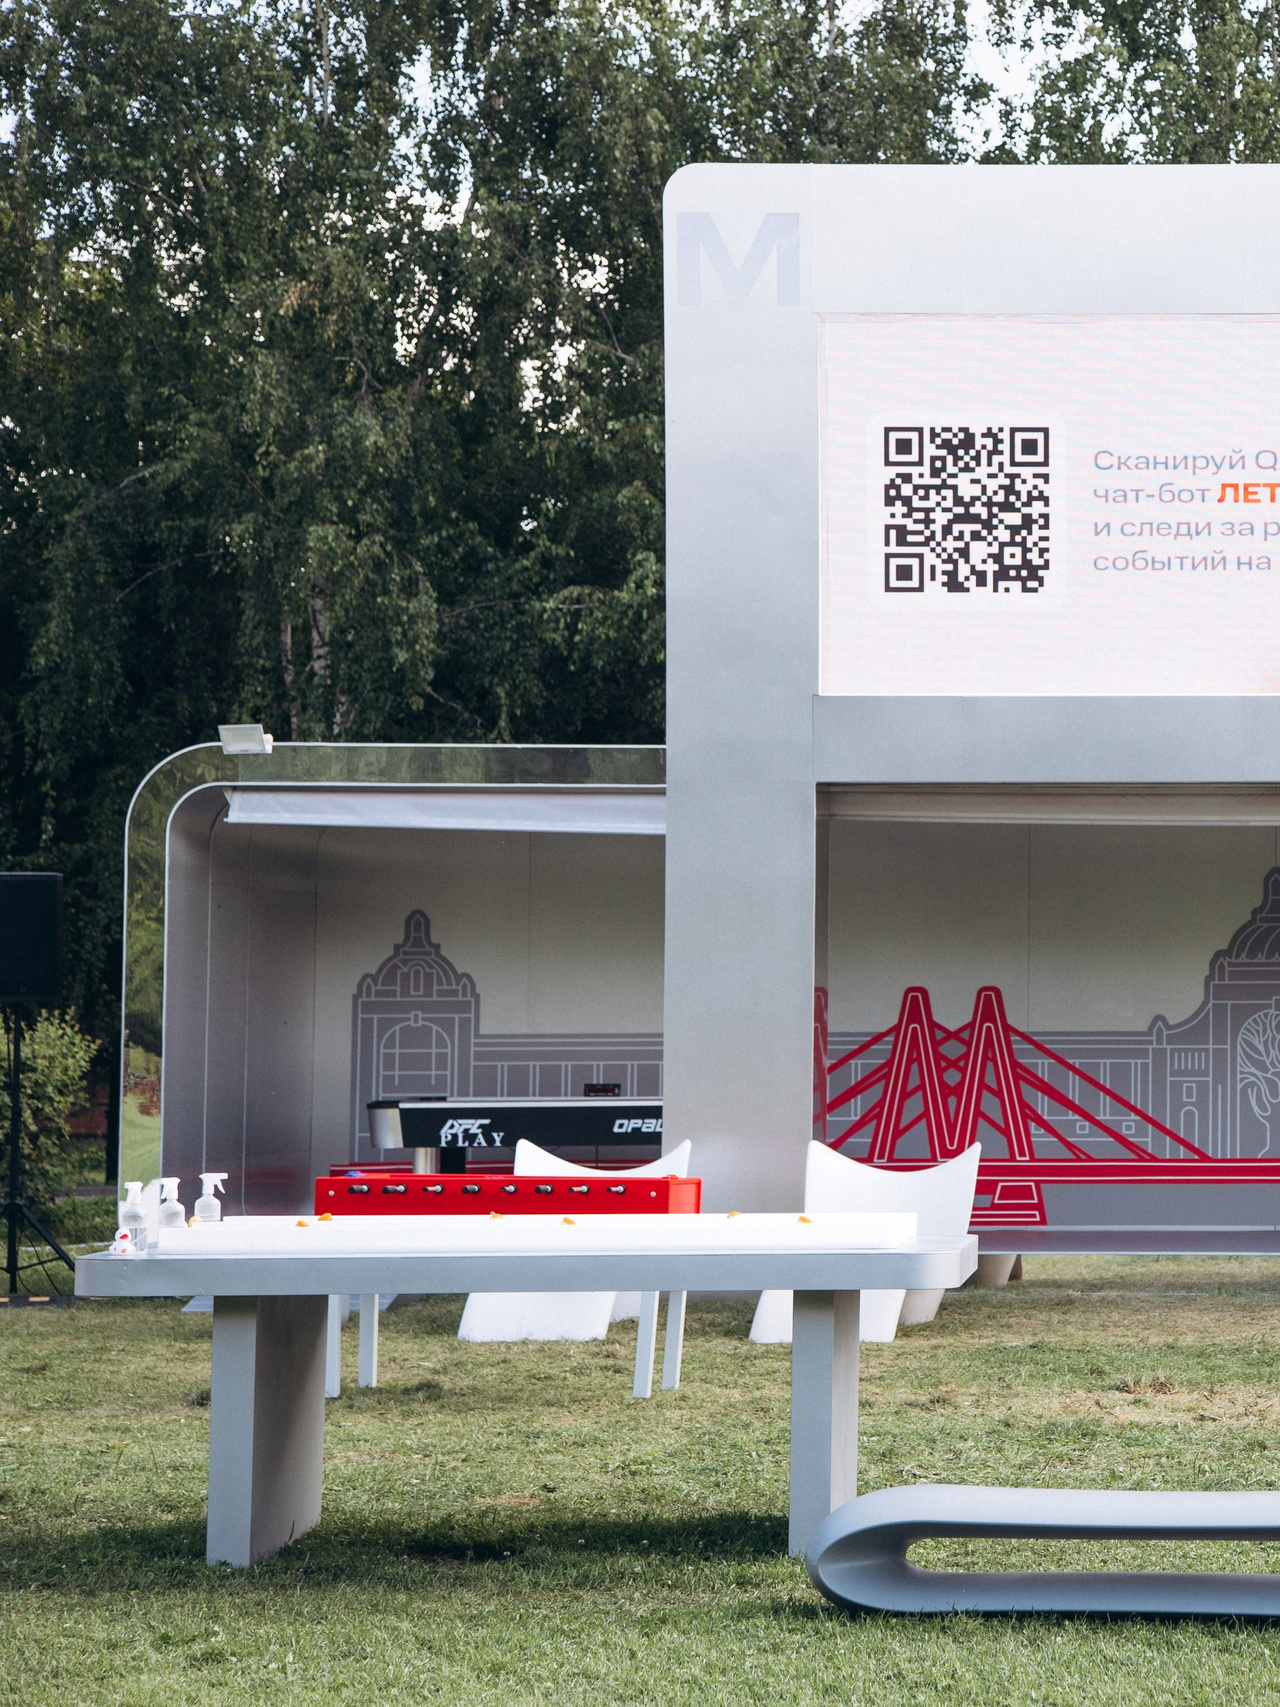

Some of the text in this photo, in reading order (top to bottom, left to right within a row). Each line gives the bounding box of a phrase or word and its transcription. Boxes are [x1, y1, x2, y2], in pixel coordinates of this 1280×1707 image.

[1093, 448, 1246, 476] Сканируй
[1093, 482, 1211, 504] чат-бот
[1093, 521, 1111, 537] и
[1120, 521, 1212, 541] следи
[1220, 520, 1255, 537] за
[1093, 549, 1227, 571] событий
[1236, 555, 1272, 571] на
[439, 1132, 505, 1148] PLAY
